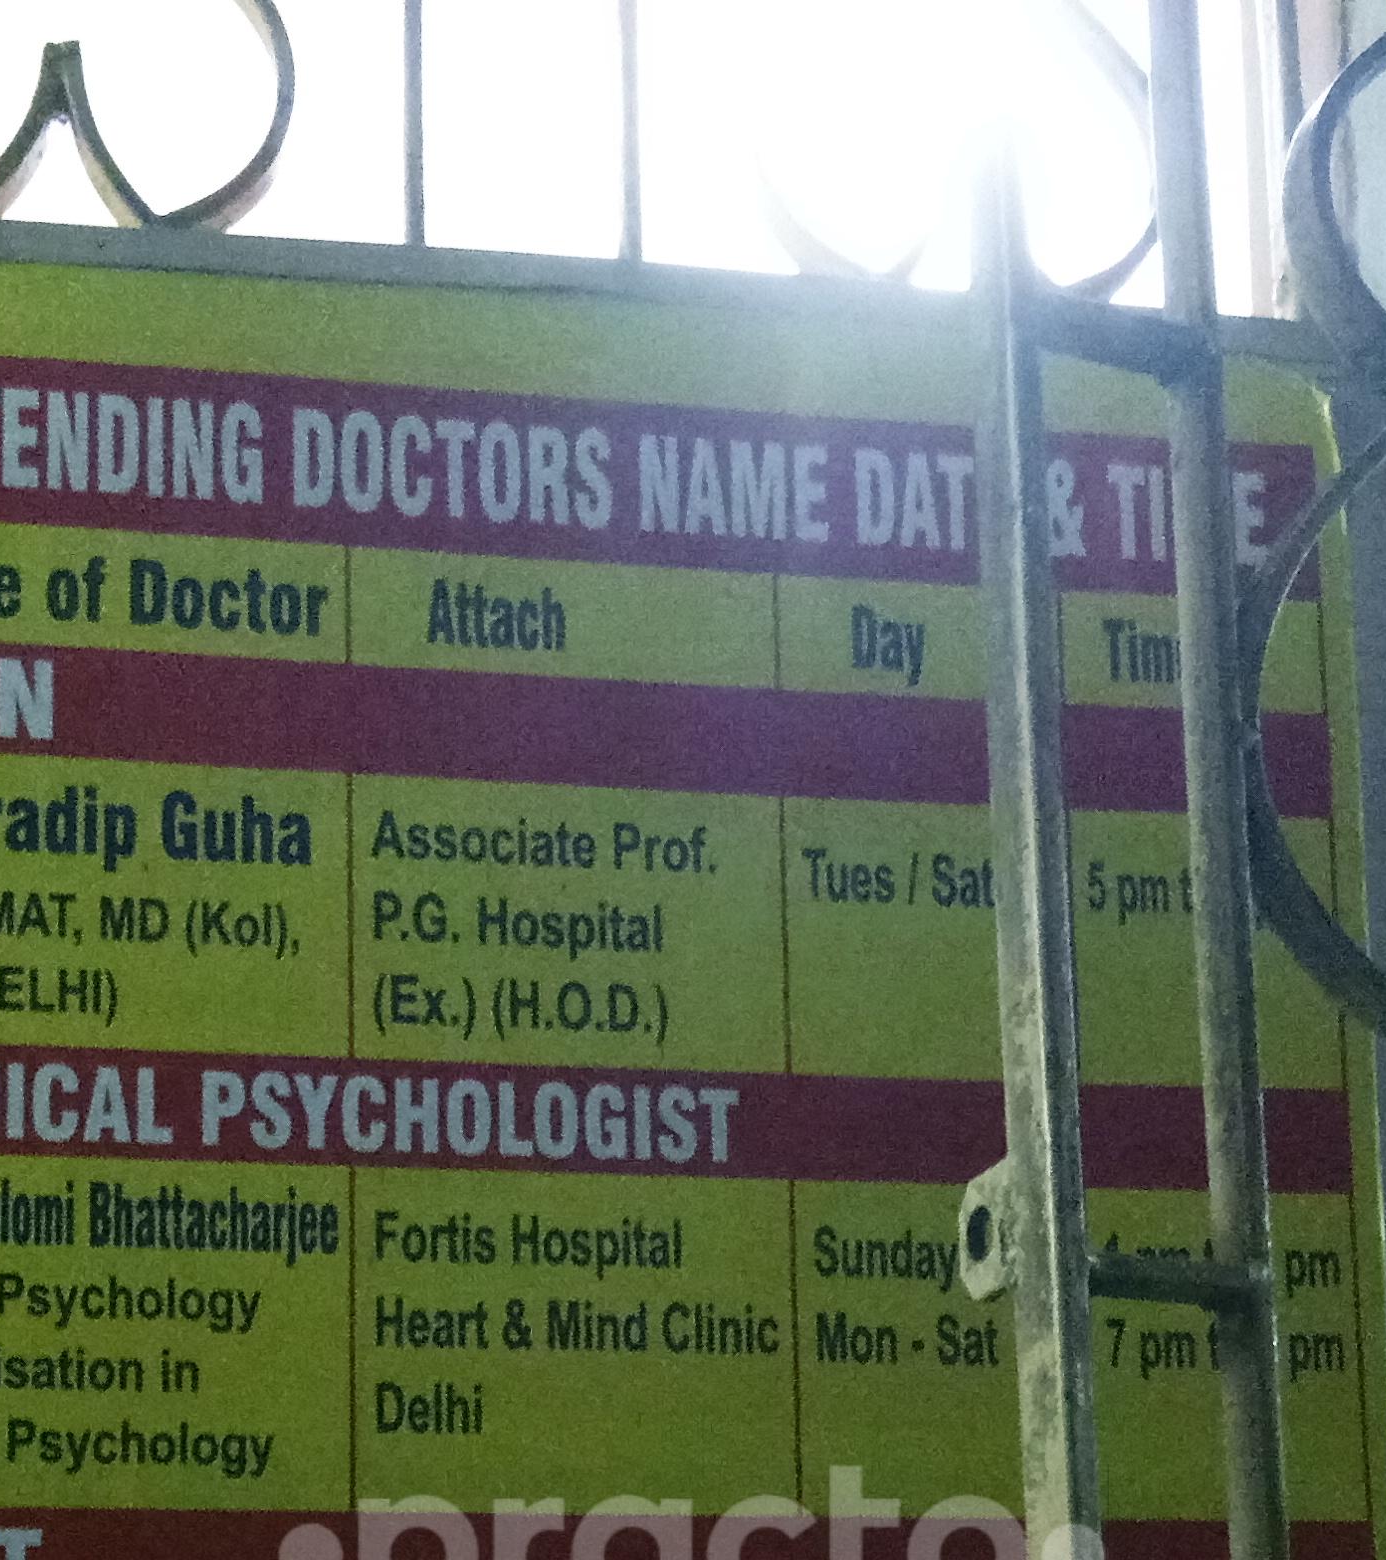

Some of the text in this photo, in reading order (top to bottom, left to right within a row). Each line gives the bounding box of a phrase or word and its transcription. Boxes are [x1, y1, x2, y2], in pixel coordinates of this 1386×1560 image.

[293, 404, 610, 530] DOCTORS
[640, 433, 828, 543] NAME
[854, 449, 975, 551] DAT
[1107, 463, 1267, 567] TIE
[46, 557, 103, 623] of
[129, 559, 329, 636] Doctor
[427, 577, 566, 652] Attach
[851, 604, 924, 687] Day
[1102, 618, 1180, 683] Tim
[161, 791, 311, 866] Guha
[371, 810, 717, 874] Associate Prof.
[803, 848, 895, 905] Tues
[1088, 862, 1106, 911] 5
[1116, 874, 1170, 925] pm
[100, 896, 169, 943] MD
[186, 898, 301, 960] (Kol),
[371, 890, 663, 961] P.G. Hospital
[374, 973, 669, 1047] (Ex.) (H.O.D.)
[201, 1070, 739, 1163] PSYCHOLOGIST
[89, 1179, 339, 1268] Bhattacharjee
[375, 1209, 683, 1281] Fortis Hospital
[813, 1225, 959, 1292] Sunday
[1285, 1250, 1341, 1298] pm
[375, 1297, 780, 1355] Heart & Mind Clinic
[815, 1311, 897, 1365] Mon
[936, 1315, 999, 1367] Sat
[1106, 1316, 1125, 1368] 7
[1140, 1332, 1196, 1380] pm
[1289, 1332, 1345, 1383] pm
[160, 1350, 200, 1393] in
[375, 1381, 484, 1434] Delhi
[6, 1416, 274, 1479] Psychology
